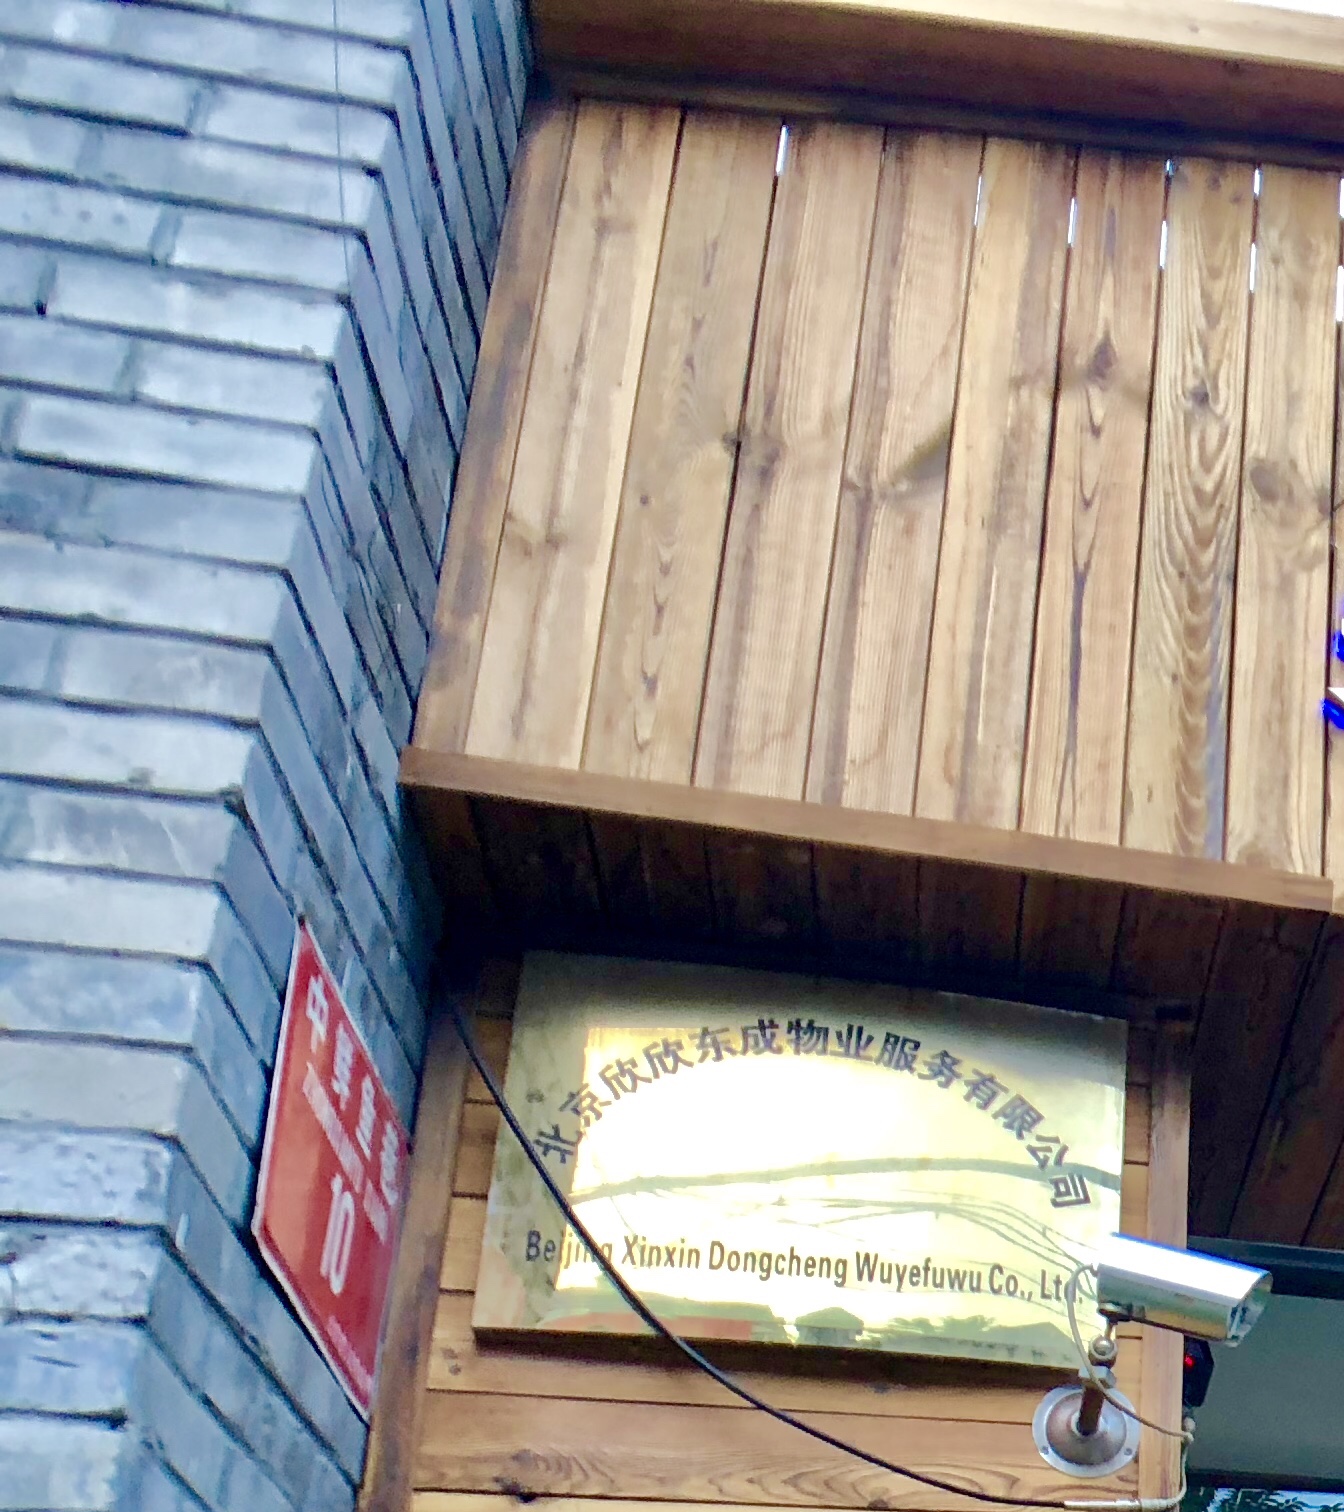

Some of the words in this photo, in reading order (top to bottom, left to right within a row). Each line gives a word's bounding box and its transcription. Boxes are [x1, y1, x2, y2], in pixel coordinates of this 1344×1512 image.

[534, 1017, 1092, 1210] 北京欣欣东成物业服务有限公司
[319, 1172, 356, 1299] 10
[622, 1234, 701, 1270] Xinxin
[708, 1240, 848, 1288] Dongcheng
[855, 1251, 983, 1293] Wuyefuwu
[988, 1263, 1034, 1302] Co.,
